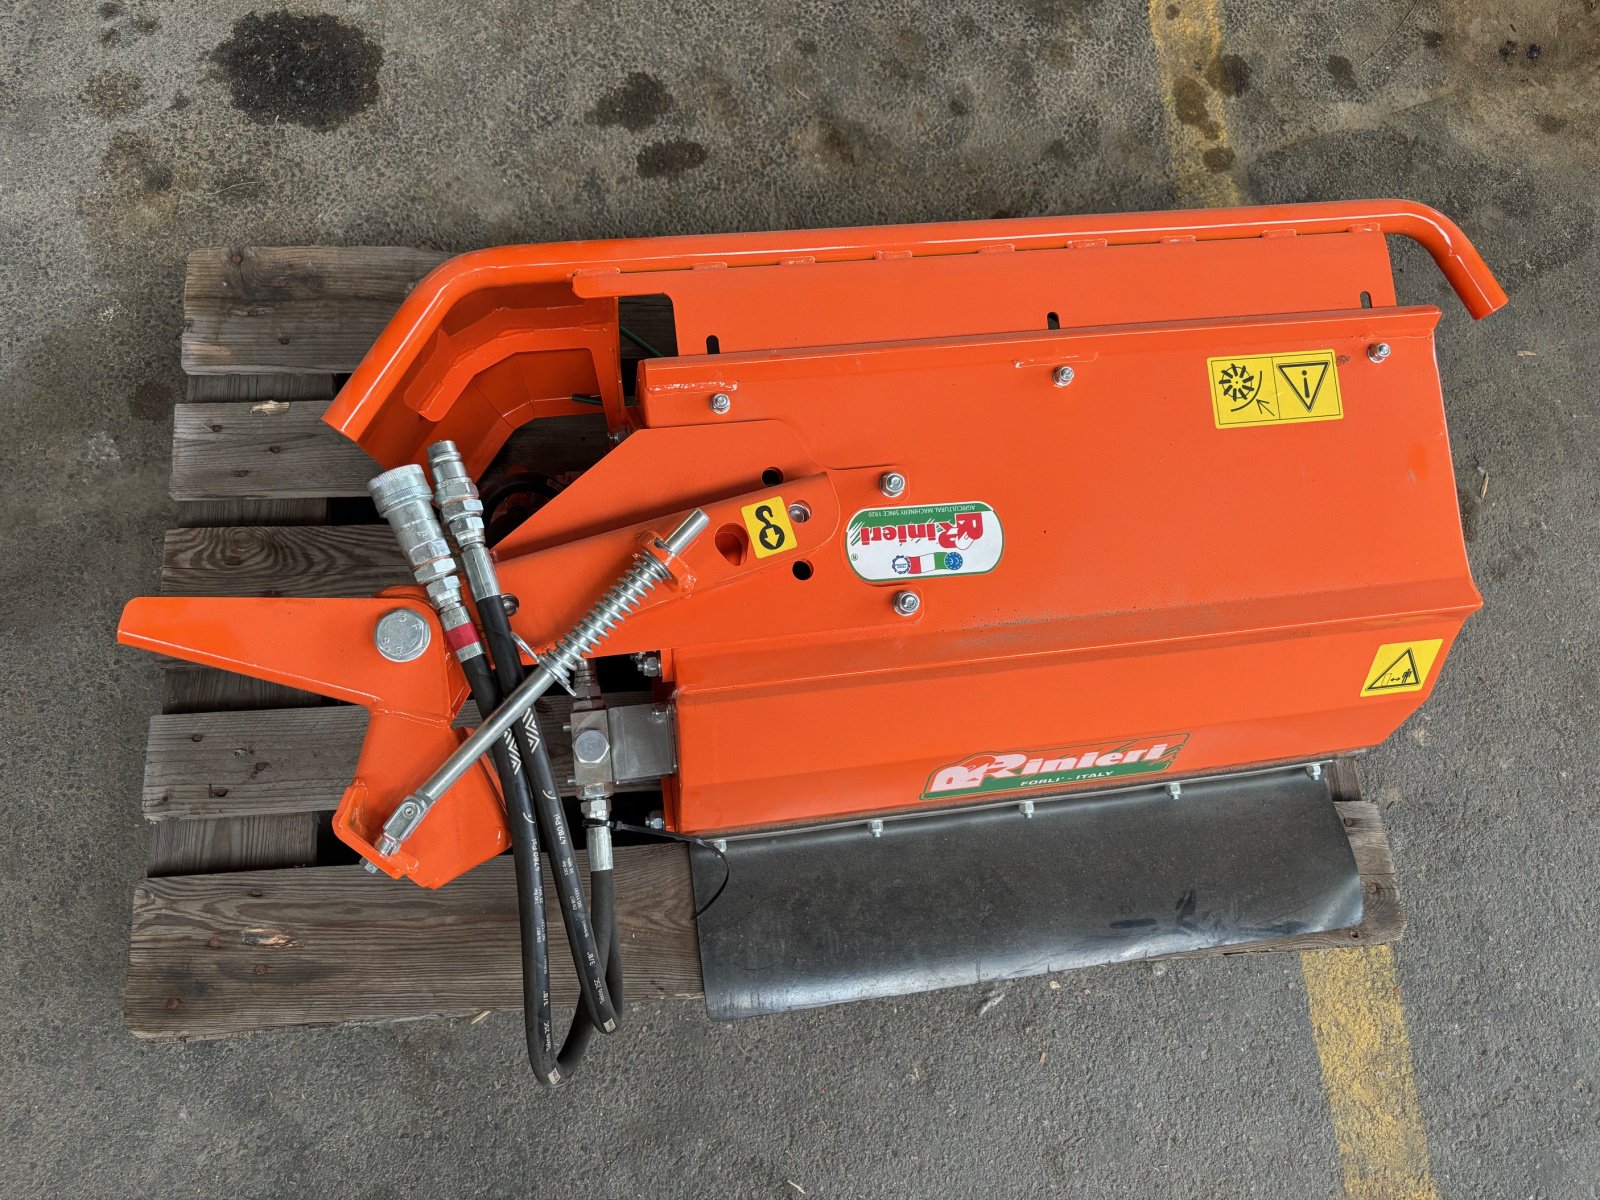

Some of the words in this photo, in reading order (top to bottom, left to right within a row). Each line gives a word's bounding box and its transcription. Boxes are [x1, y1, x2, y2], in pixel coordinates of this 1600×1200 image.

[900, 507, 934, 515] MACHINERY
[934, 504, 976, 513] AGRICULTURAL
[1073, 770, 1115, 781] ITALY
[557, 826, 567, 845] 4780
[532, 851, 541, 872] 4780
